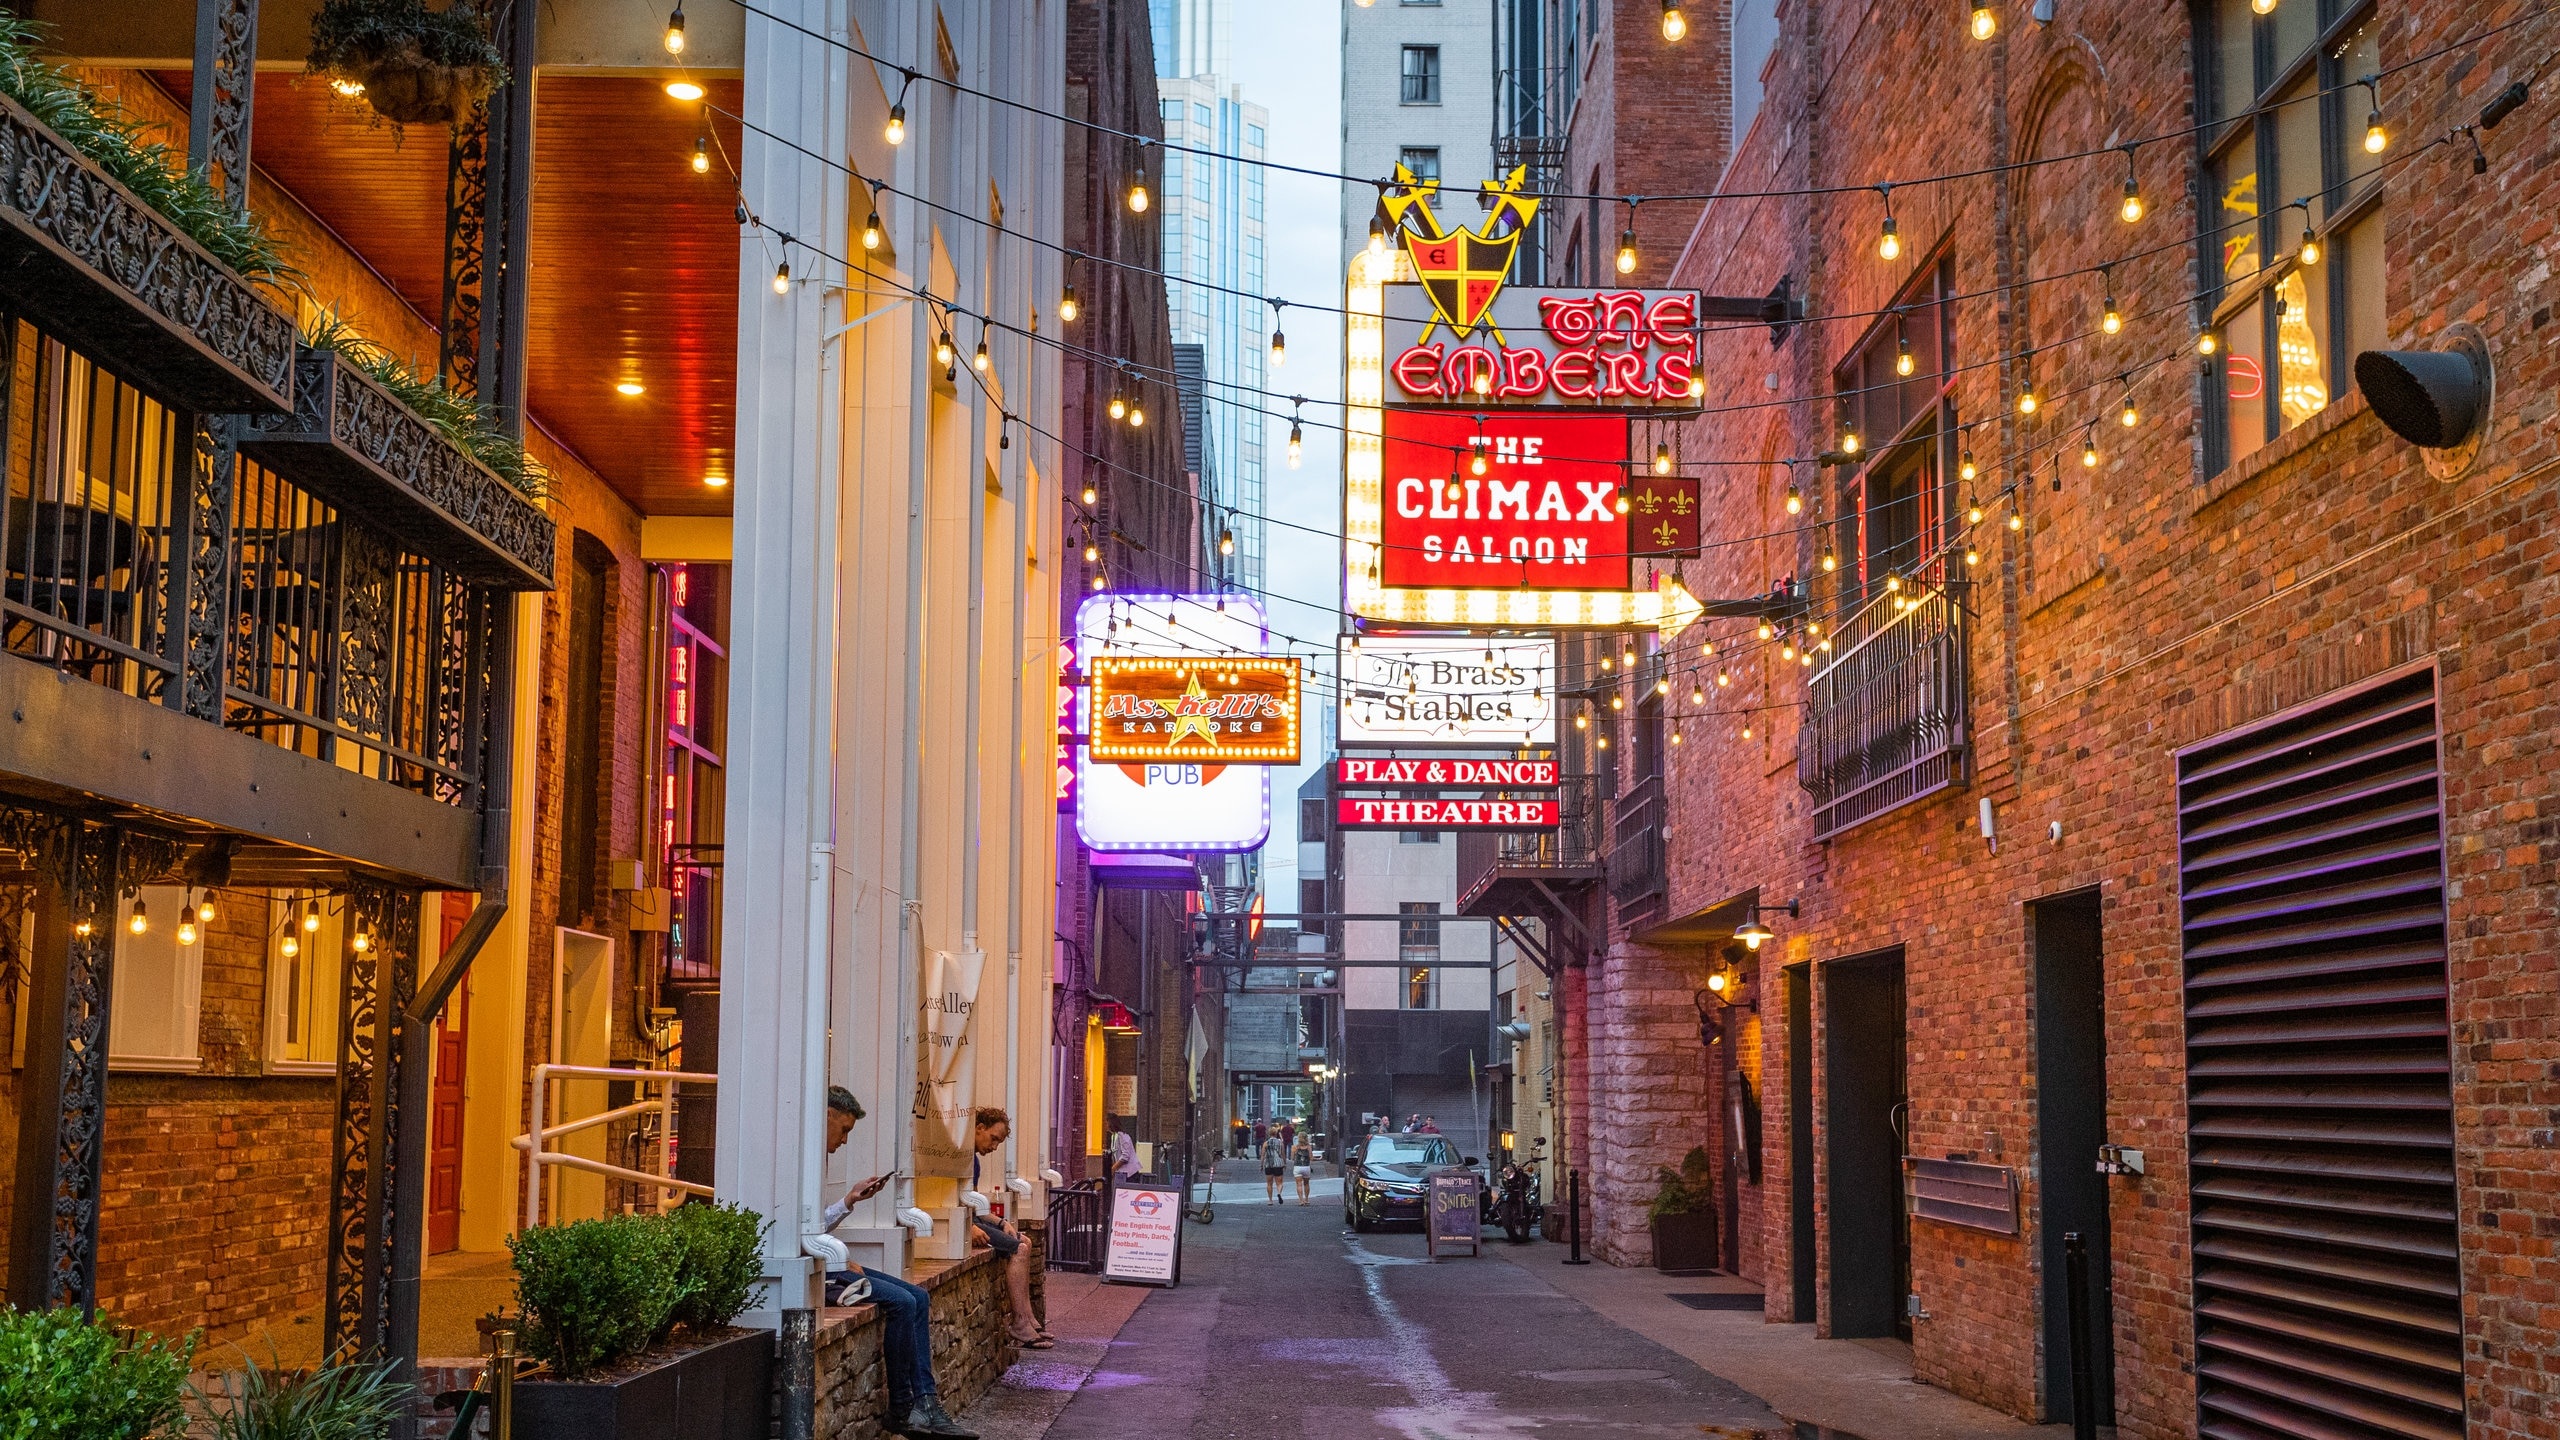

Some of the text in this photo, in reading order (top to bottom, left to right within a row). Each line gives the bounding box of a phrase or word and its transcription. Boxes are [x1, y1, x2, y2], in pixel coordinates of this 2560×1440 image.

[1468, 436, 1543, 465] THE
[1397, 478, 1615, 521] CLIMAX
[1423, 535, 1588, 565] SALOON
[1431, 660, 1526, 686] Brass
[1104, 694, 1283, 719] Ms. Kelli's
[1384, 694, 1513, 721] Stables
[1123, 721, 1263, 733] KARAOKE
[1148, 764, 1200, 785] PUB
[1346, 761, 1553, 783] PLAY & DANCE
[1355, 802, 1544, 823] THEATRE
[1114, 1230, 1130, 1239] Tasty
[1130, 1222, 1153, 1230] English
